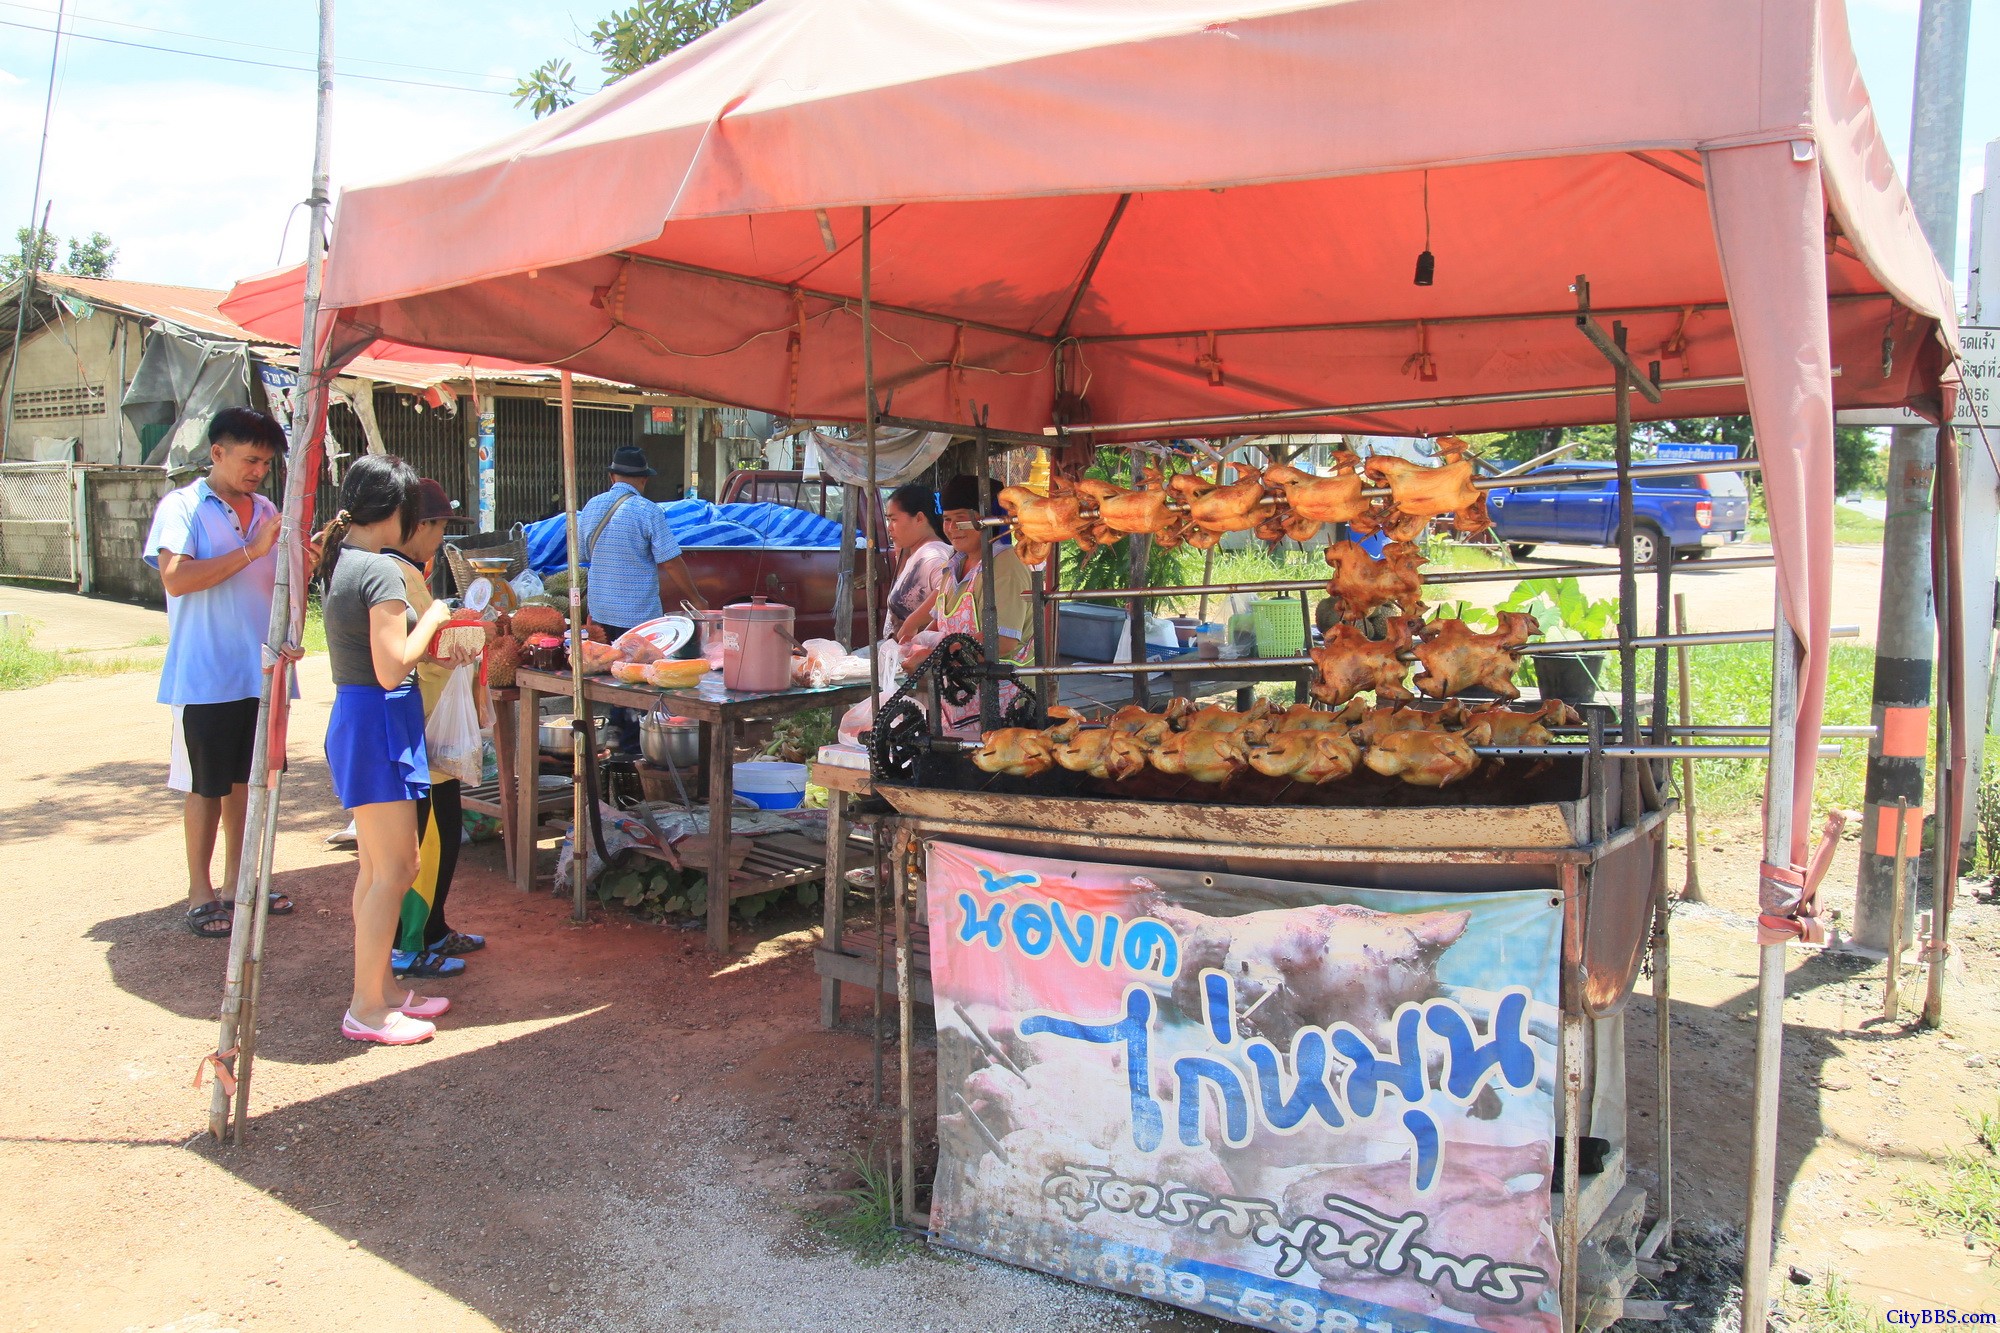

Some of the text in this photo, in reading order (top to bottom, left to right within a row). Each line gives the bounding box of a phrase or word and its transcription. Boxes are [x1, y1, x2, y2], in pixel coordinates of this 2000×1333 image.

[1958, 331, 1995, 350] รดแจ้ง
[1018, 969, 1538, 1195] ไก่หมุน
